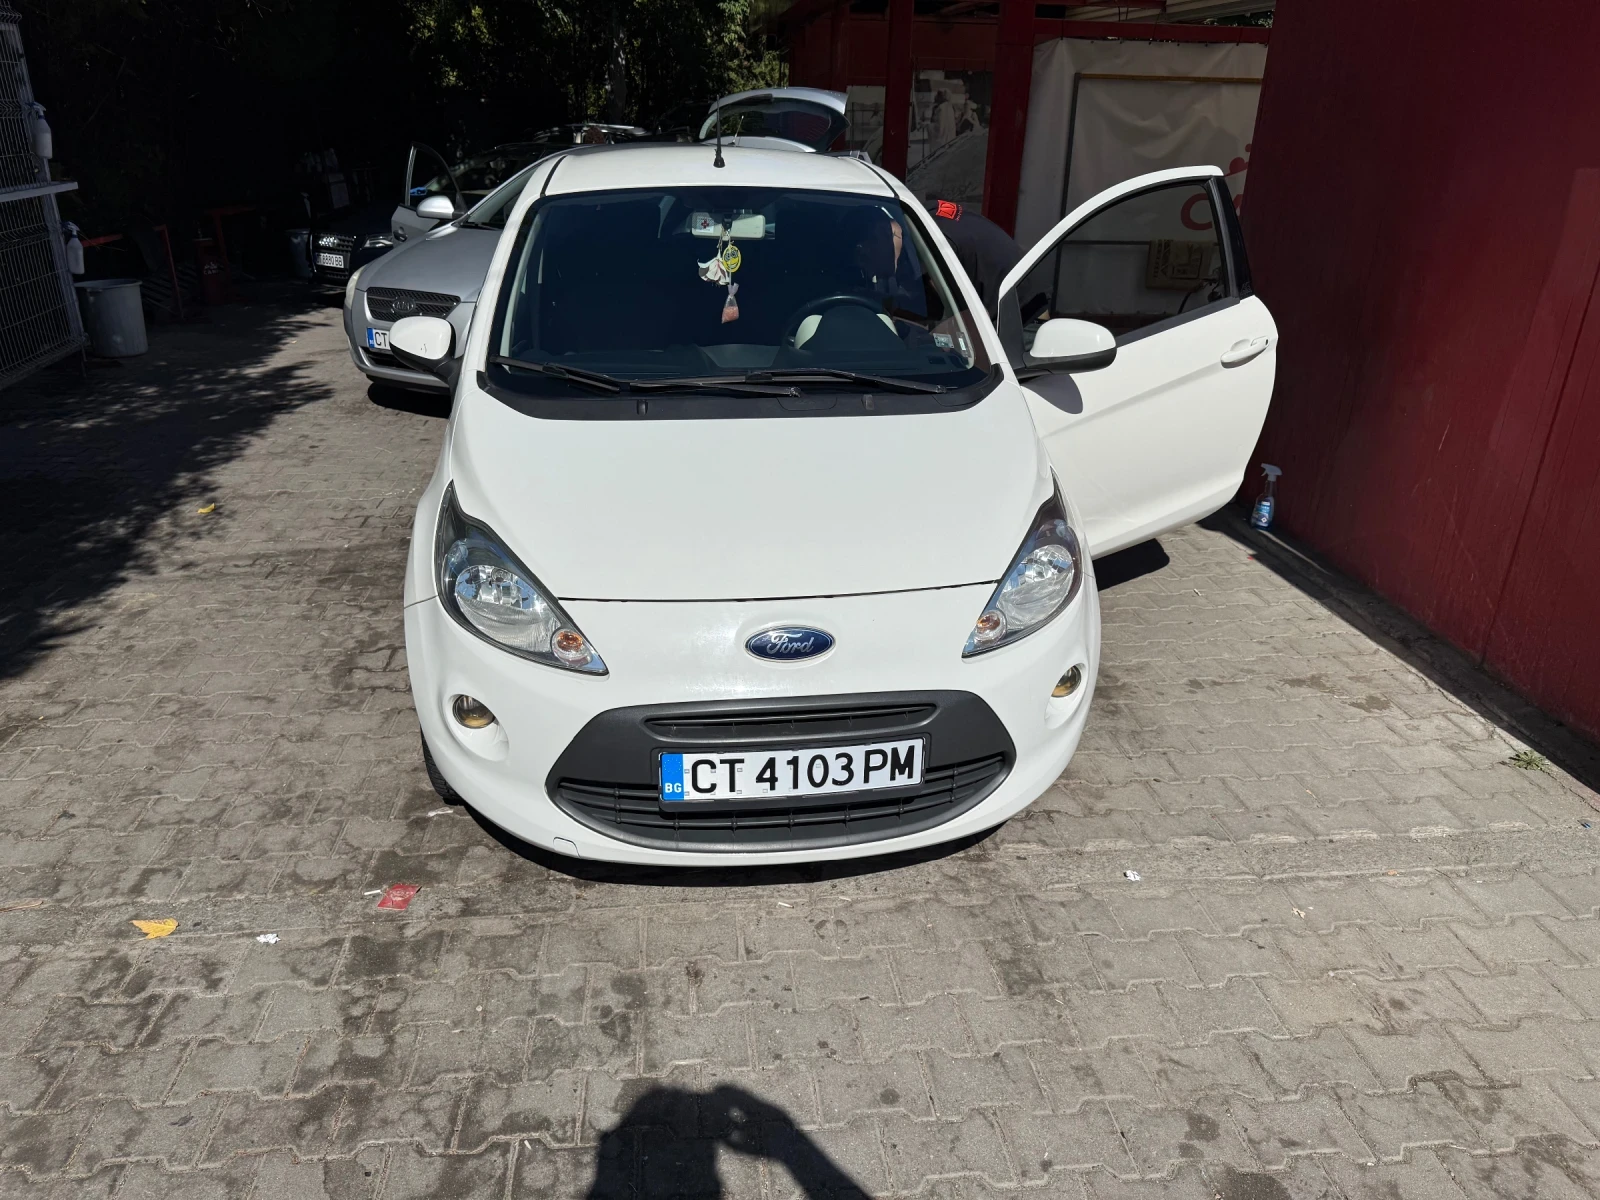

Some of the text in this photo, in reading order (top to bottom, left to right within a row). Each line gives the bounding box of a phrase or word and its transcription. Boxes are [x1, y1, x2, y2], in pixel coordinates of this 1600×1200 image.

[374, 331, 388, 348] CT
[766, 632, 815, 654] Ford
[691, 745, 915, 793] CT 4103 PM
[664, 783, 682, 793] BG
